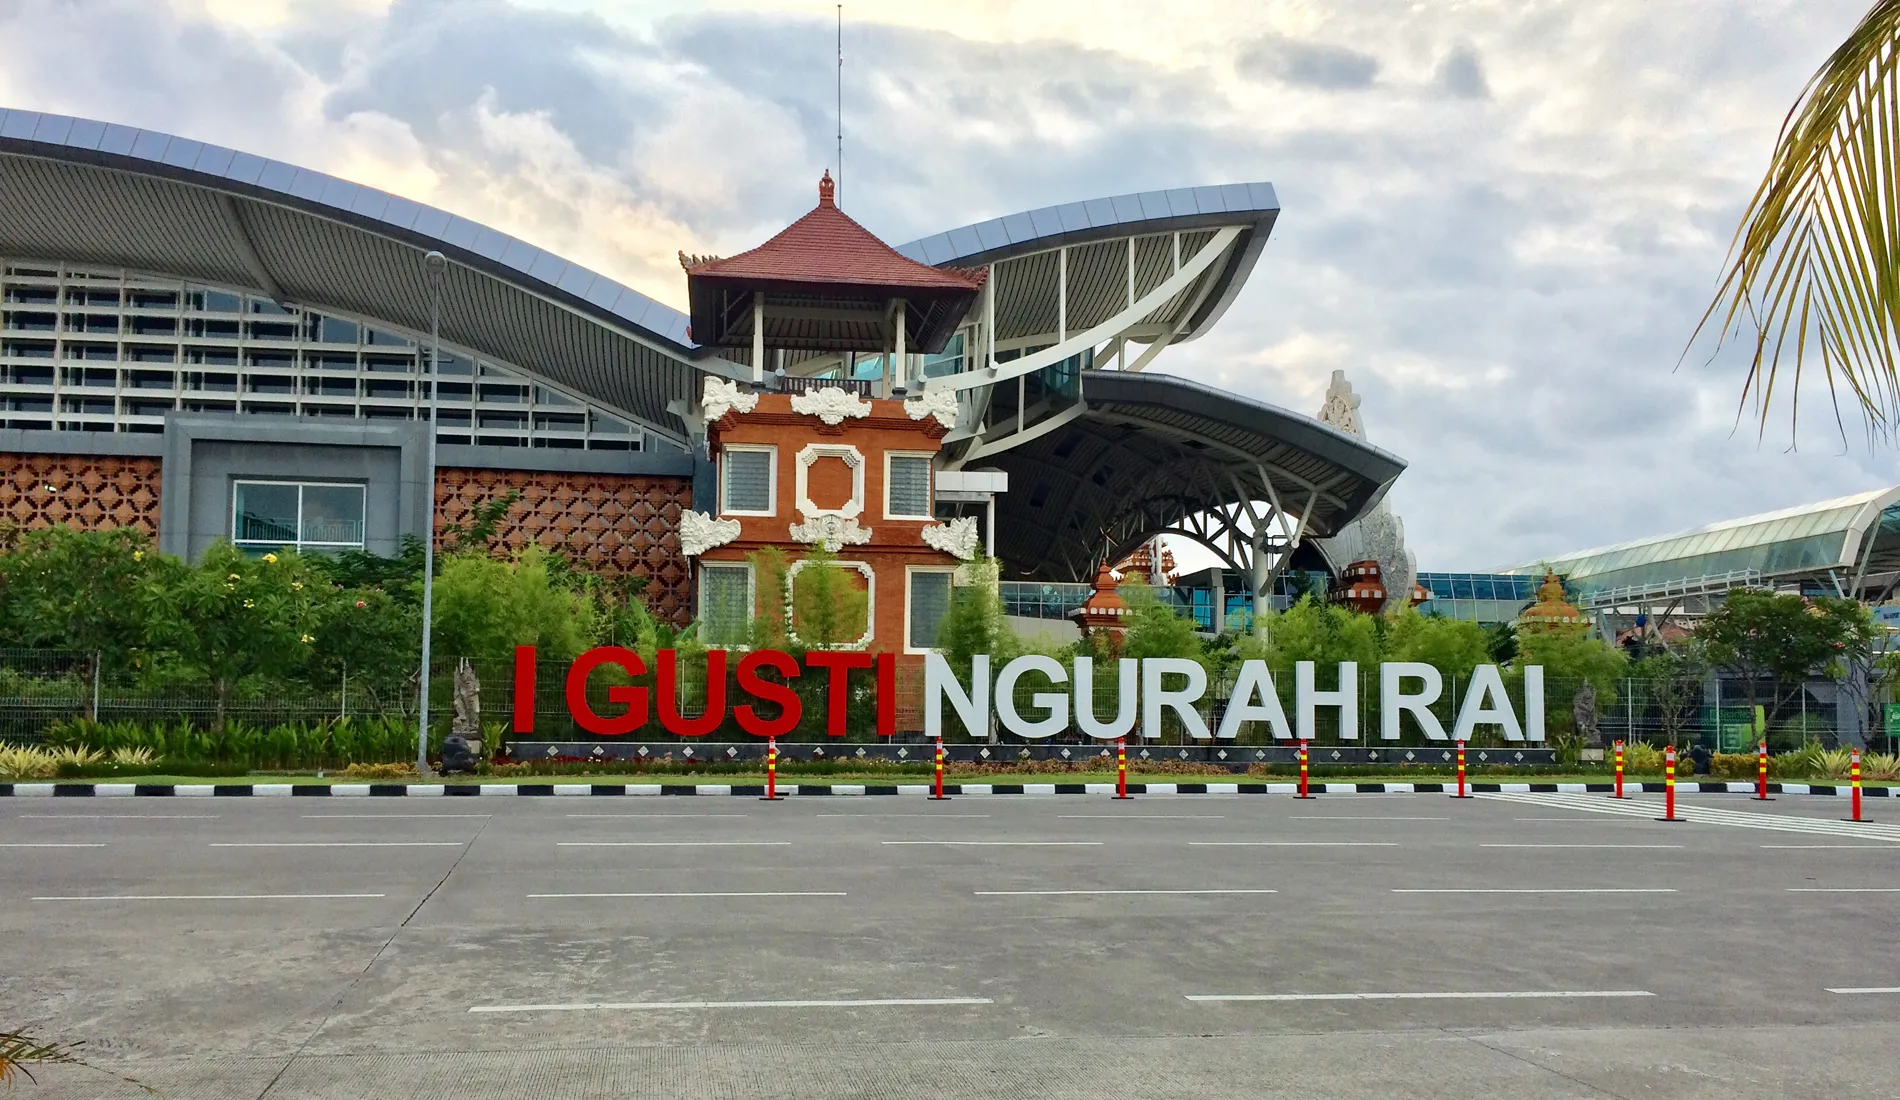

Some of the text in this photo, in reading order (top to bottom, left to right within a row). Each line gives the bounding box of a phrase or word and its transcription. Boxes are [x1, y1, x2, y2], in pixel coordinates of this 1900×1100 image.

[513, 645, 1546, 742] I GUSTI NGURAH RAI
